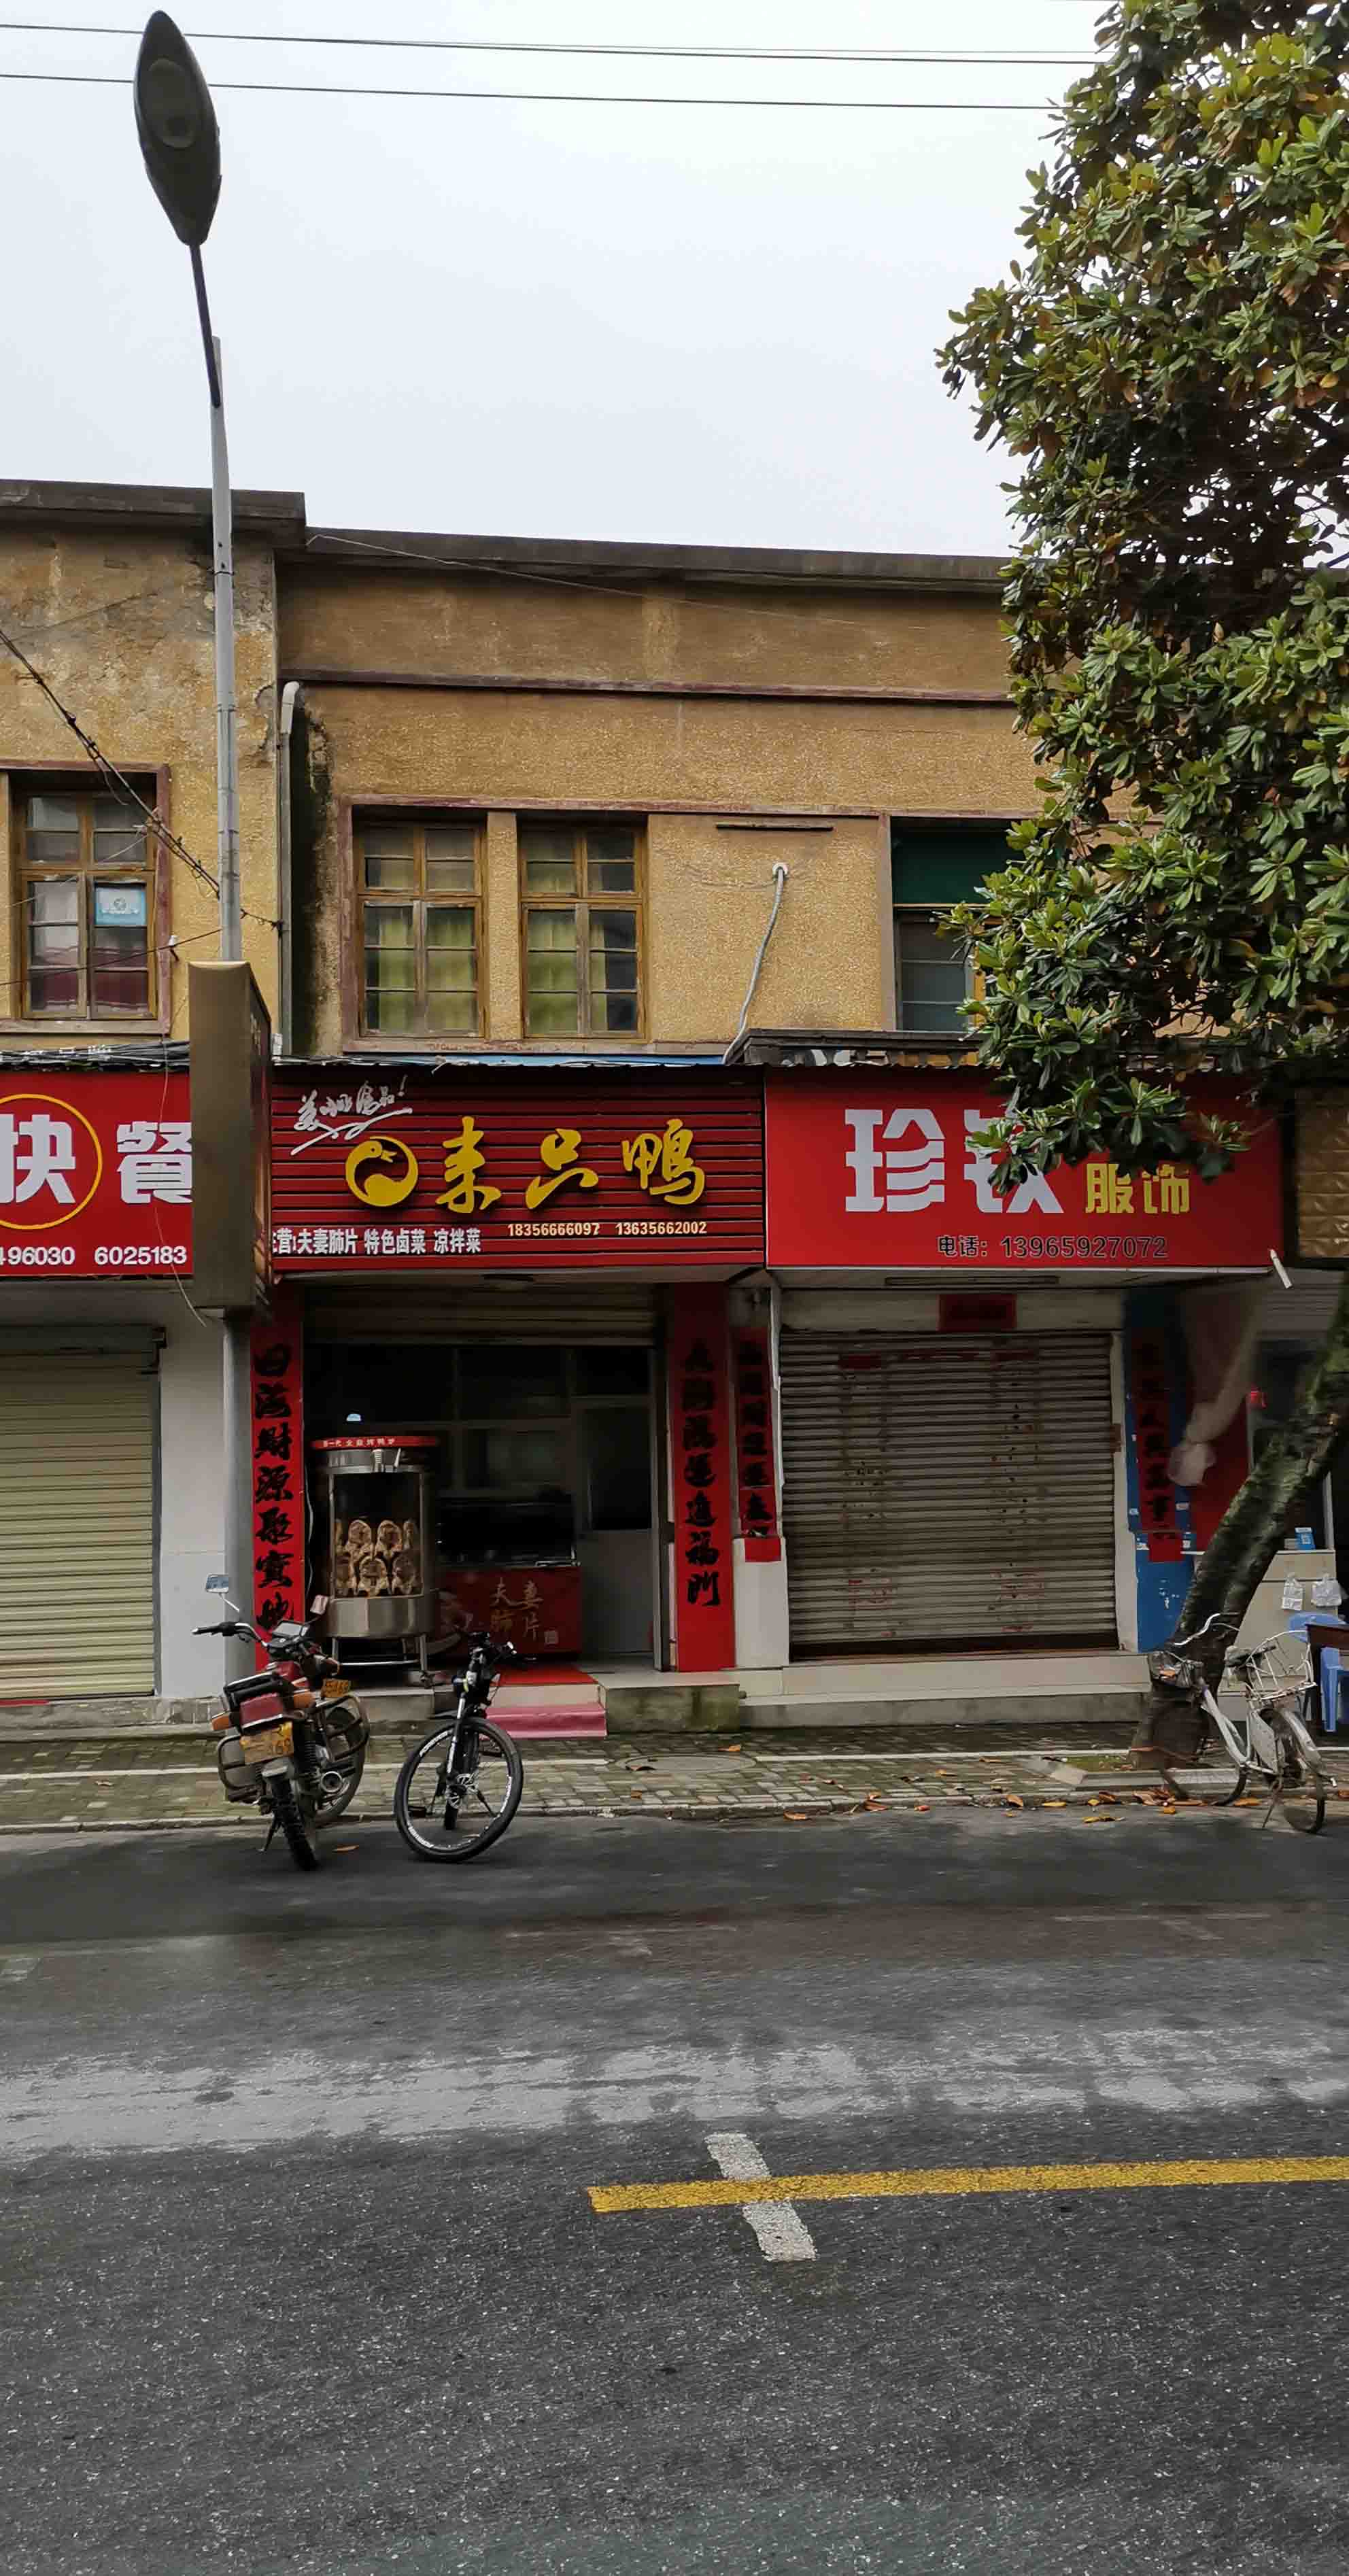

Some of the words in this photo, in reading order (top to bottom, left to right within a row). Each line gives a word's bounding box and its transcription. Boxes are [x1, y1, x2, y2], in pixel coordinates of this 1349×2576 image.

[507, 1222, 600, 1237] 18356666097
[615, 1221, 708, 1235] 13635662002
[364, 1228, 426, 1254] 特色卤菜
[433, 1227, 481, 1254] 凉拌菜
[1000, 1235, 1168, 1258] 13965927072
[94, 1246, 188, 1265] 6025183
